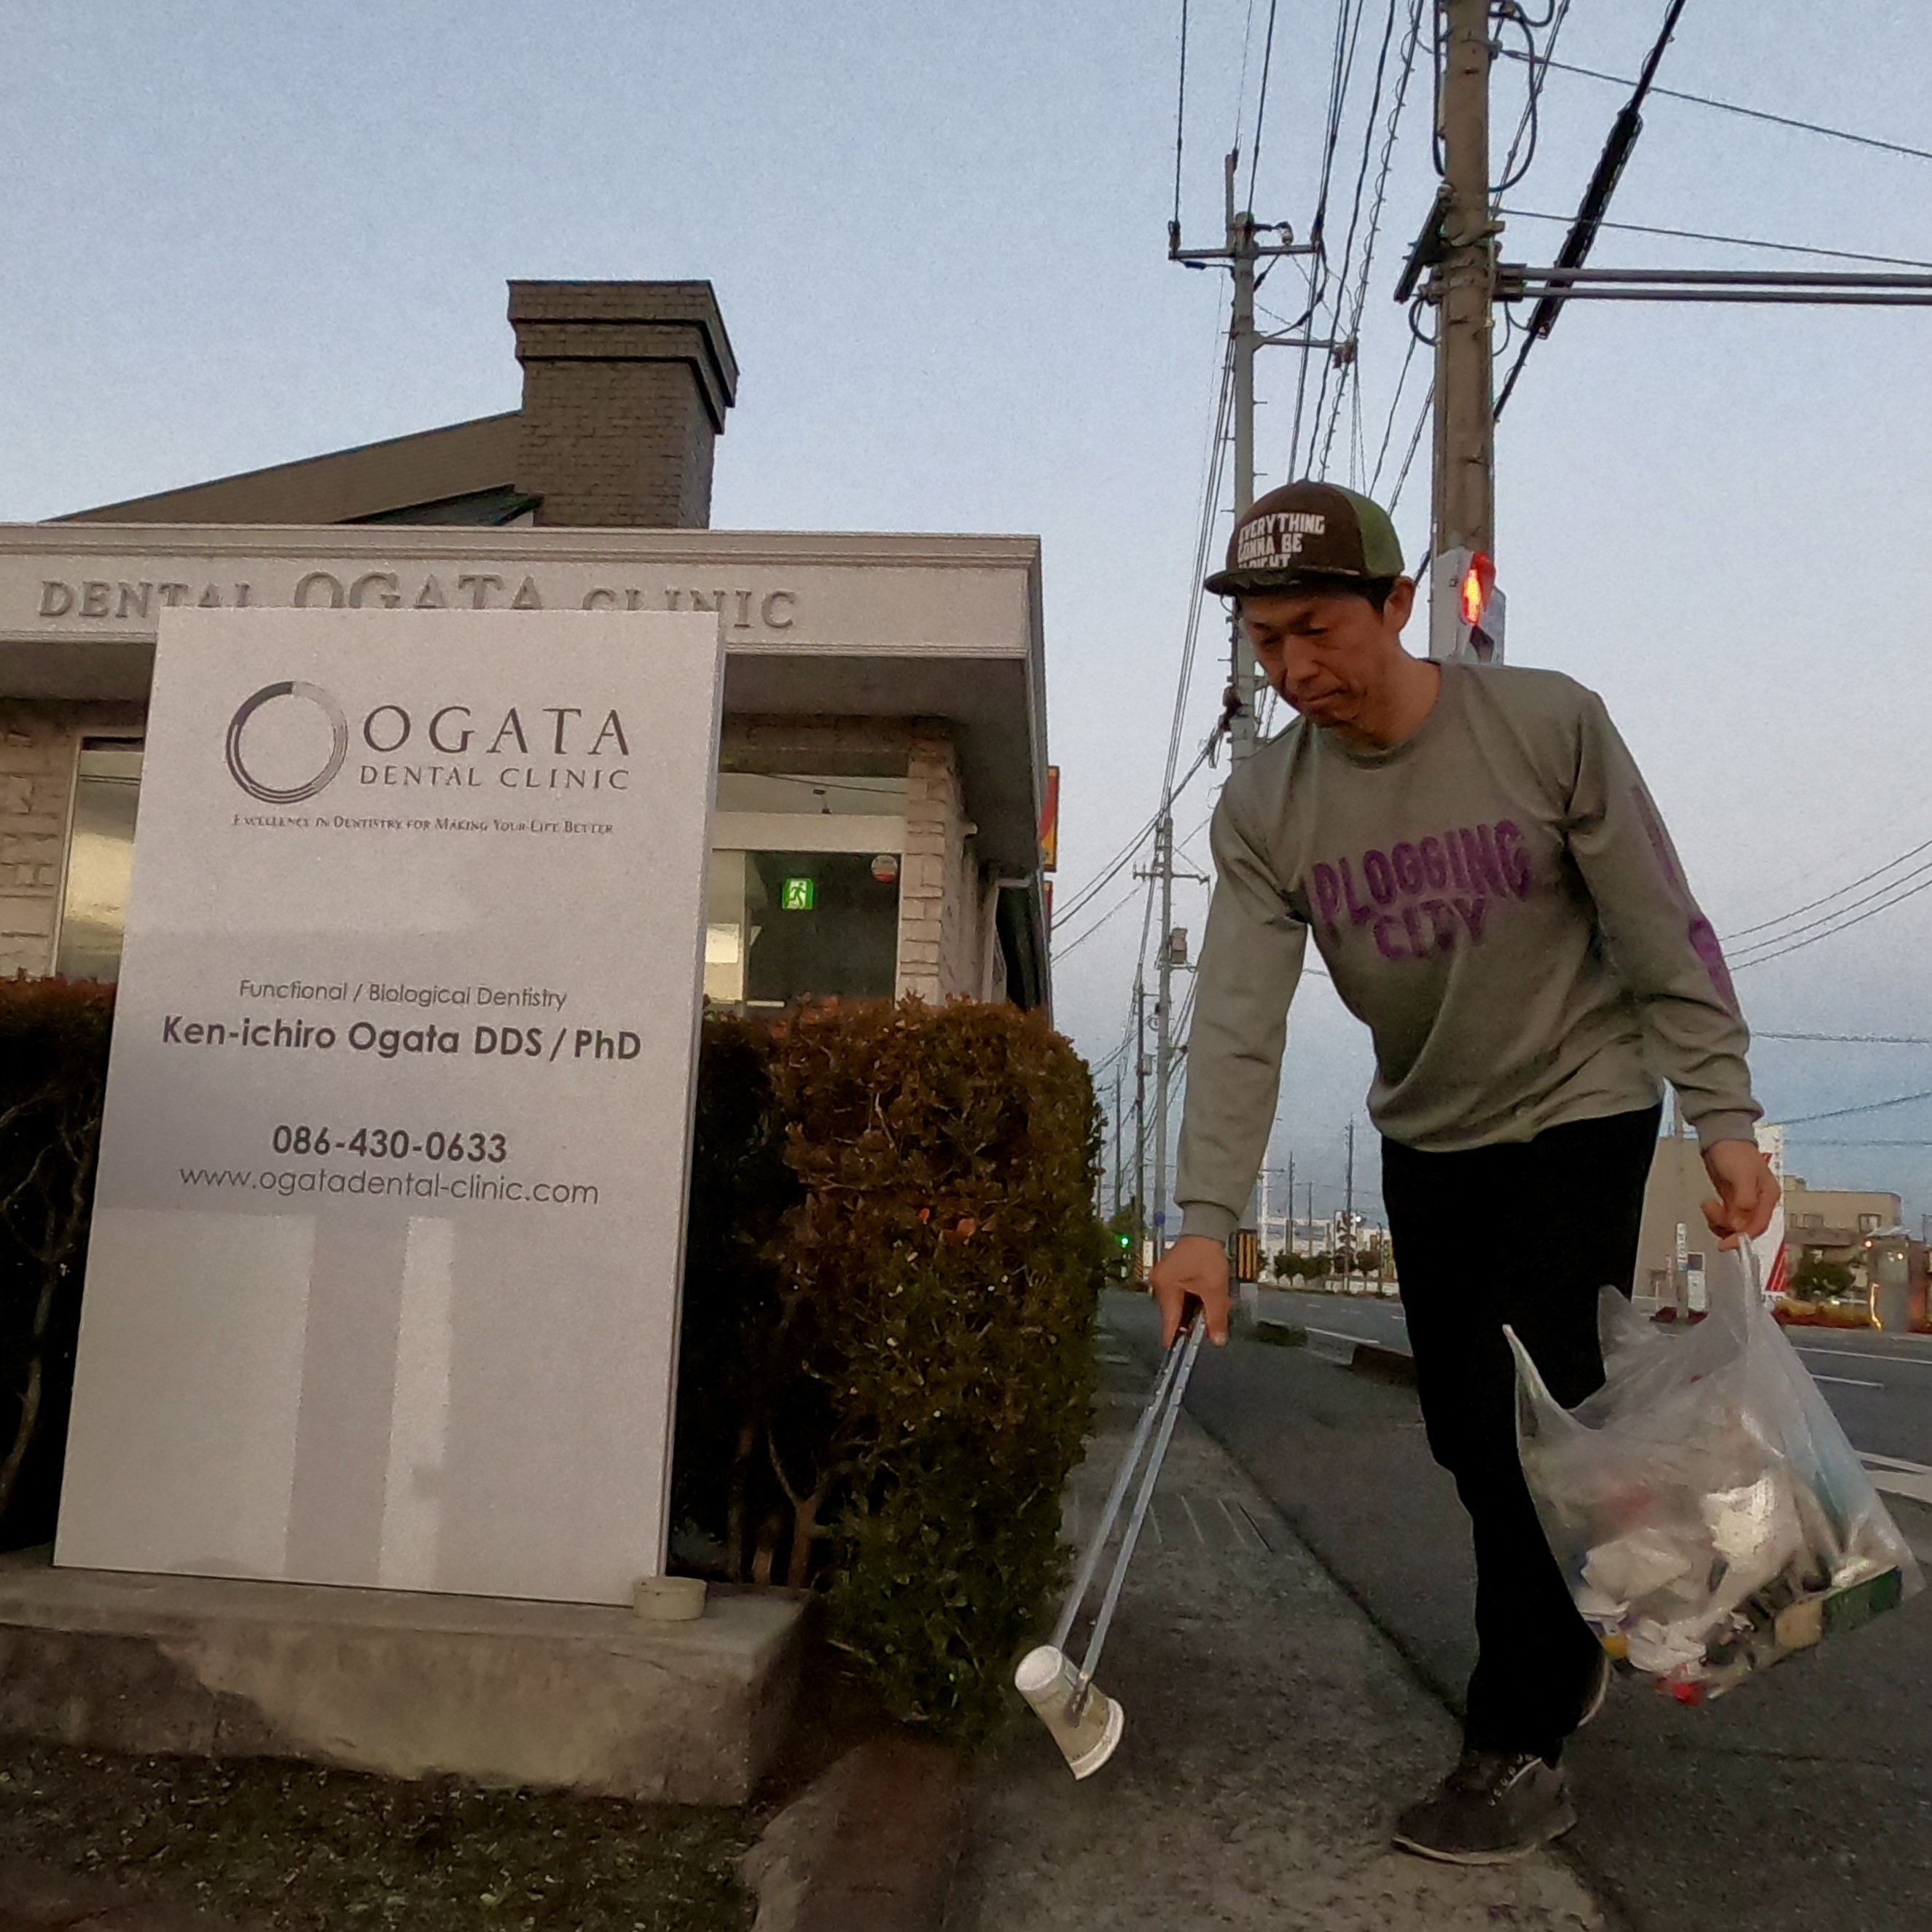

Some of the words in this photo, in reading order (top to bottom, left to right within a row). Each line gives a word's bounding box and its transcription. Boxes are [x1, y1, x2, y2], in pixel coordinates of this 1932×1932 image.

[1238, 512, 1325, 544] EVERYTHING
[1281, 533, 1302, 553] BE
[364, 705, 630, 756] OGATA
[361, 765, 482, 786] DENTAL
[500, 768, 629, 790] CLINIC
[1312, 819, 1530, 947] PLOGGING
[1374, 899, 1485, 959] CITY
[240, 979, 348, 1001] Functional
[369, 983, 471, 1007] Biological
[477, 987, 567, 1012] Dentistry
[163, 1015, 336, 1049] Ken-ichiro
[348, 1022, 459, 1058] Ogata
[474, 1025, 542, 1057] DDS
[574, 1029, 641, 1060] PhD
[273, 1125, 507, 1163] 086-430-0633
[179, 1168, 598, 1205] www.ogatadental-clinic.com
